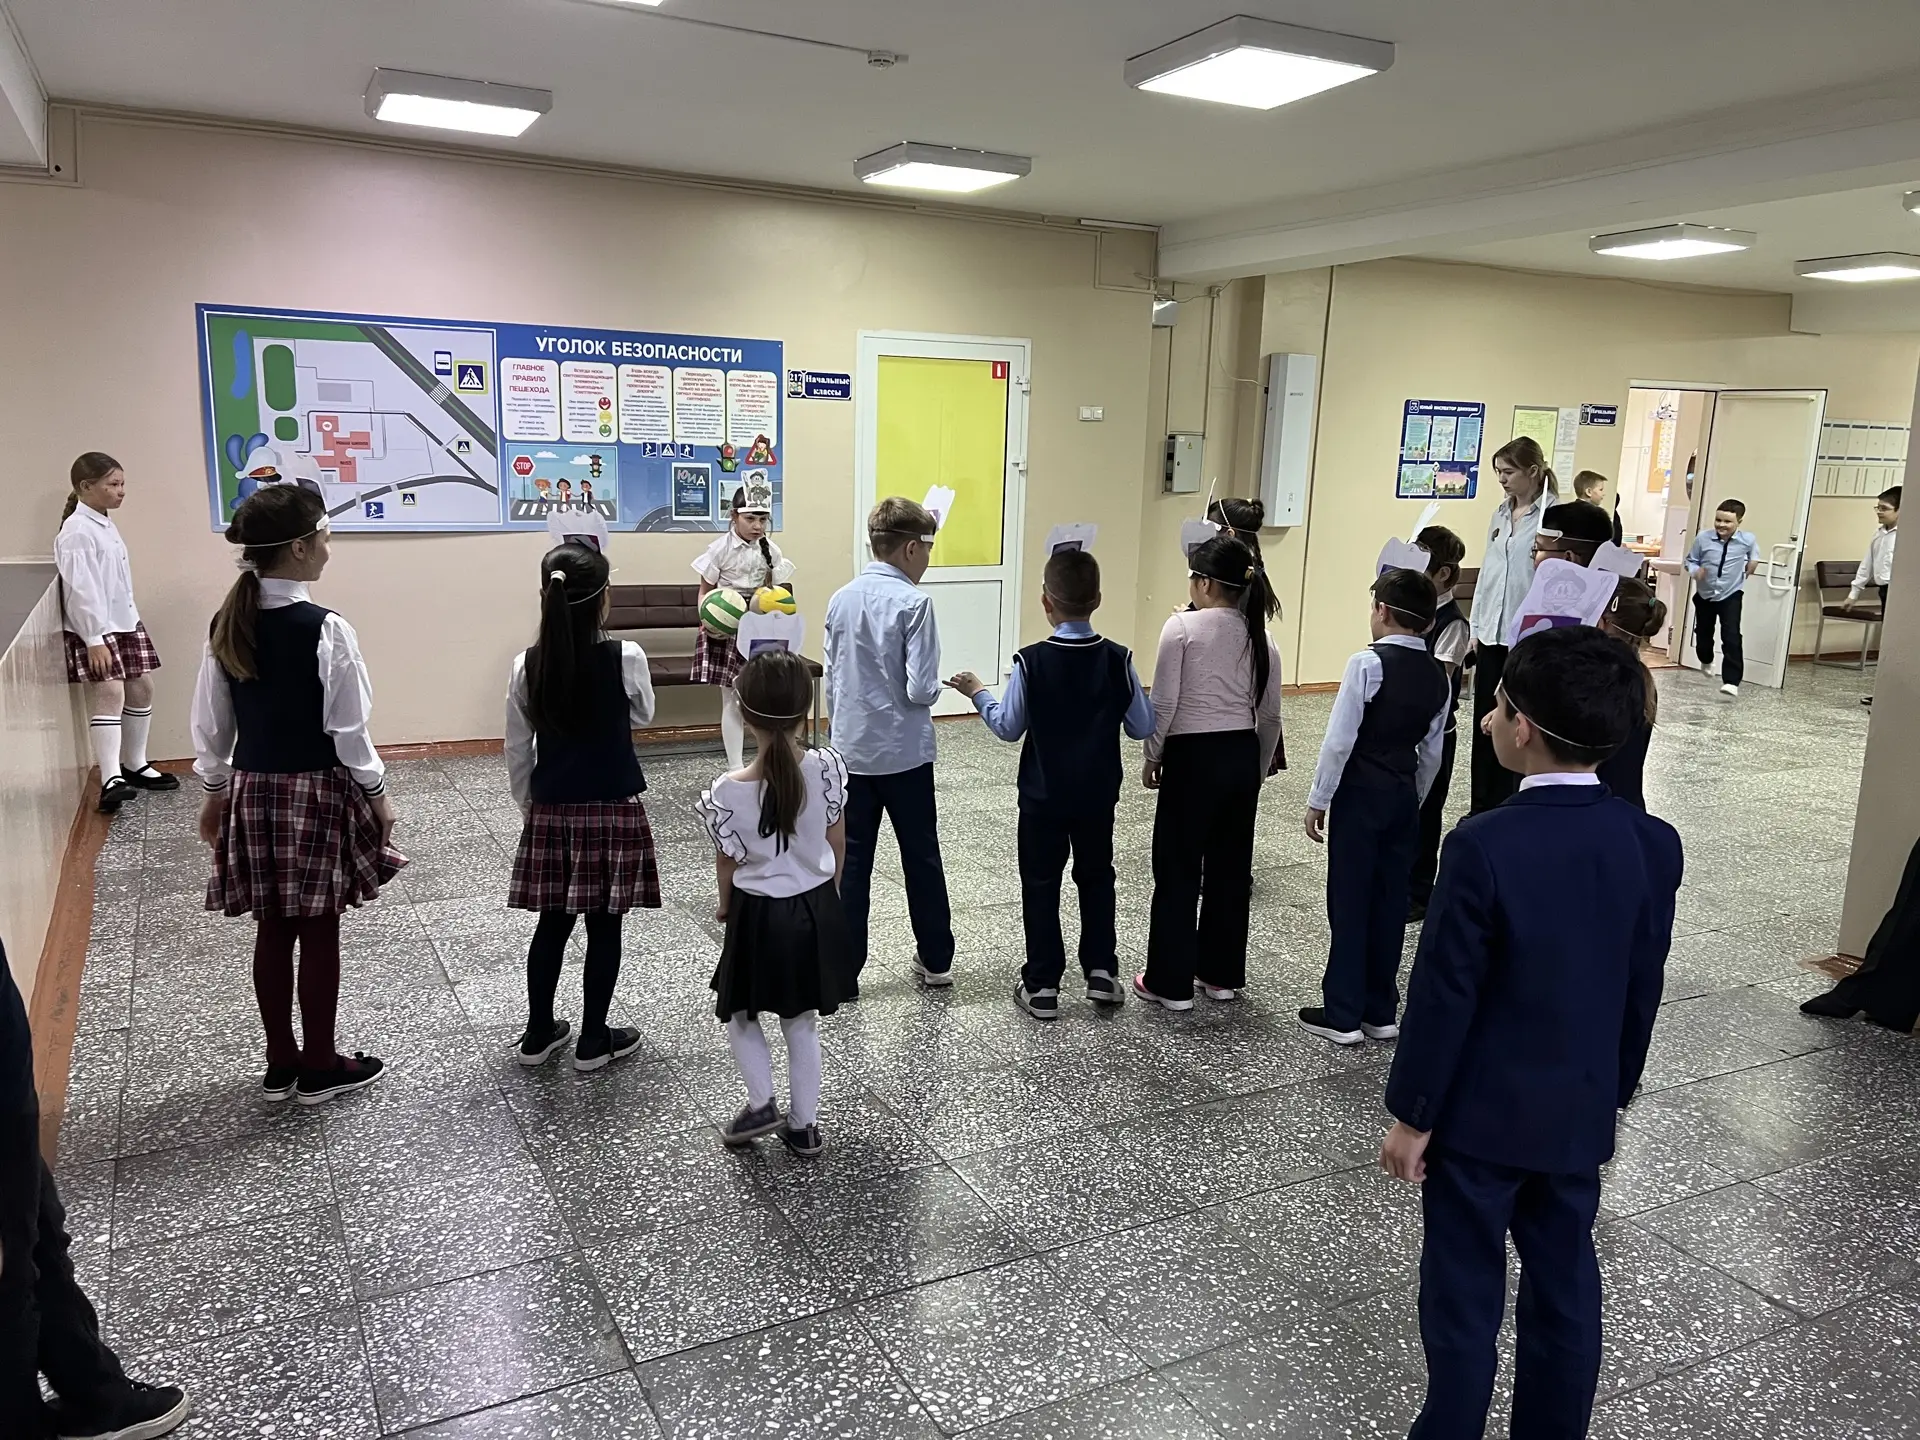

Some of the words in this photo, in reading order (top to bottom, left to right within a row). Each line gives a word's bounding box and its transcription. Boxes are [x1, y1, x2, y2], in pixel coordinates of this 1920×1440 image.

[535, 336, 606, 356] УГОЛОК
[611, 341, 743, 364] БЕЗОПАСНОСТИ
[512, 363, 545, 371] ГЛАВНОЕ
[512, 374, 547, 383] ПРАВИЛО
[789, 373, 803, 382] 217
[805, 374, 850, 385] Начальные
[509, 385, 550, 394] ПЕШЕХОДА
[813, 388, 842, 397] классы
[515, 461, 532, 470] STOP
